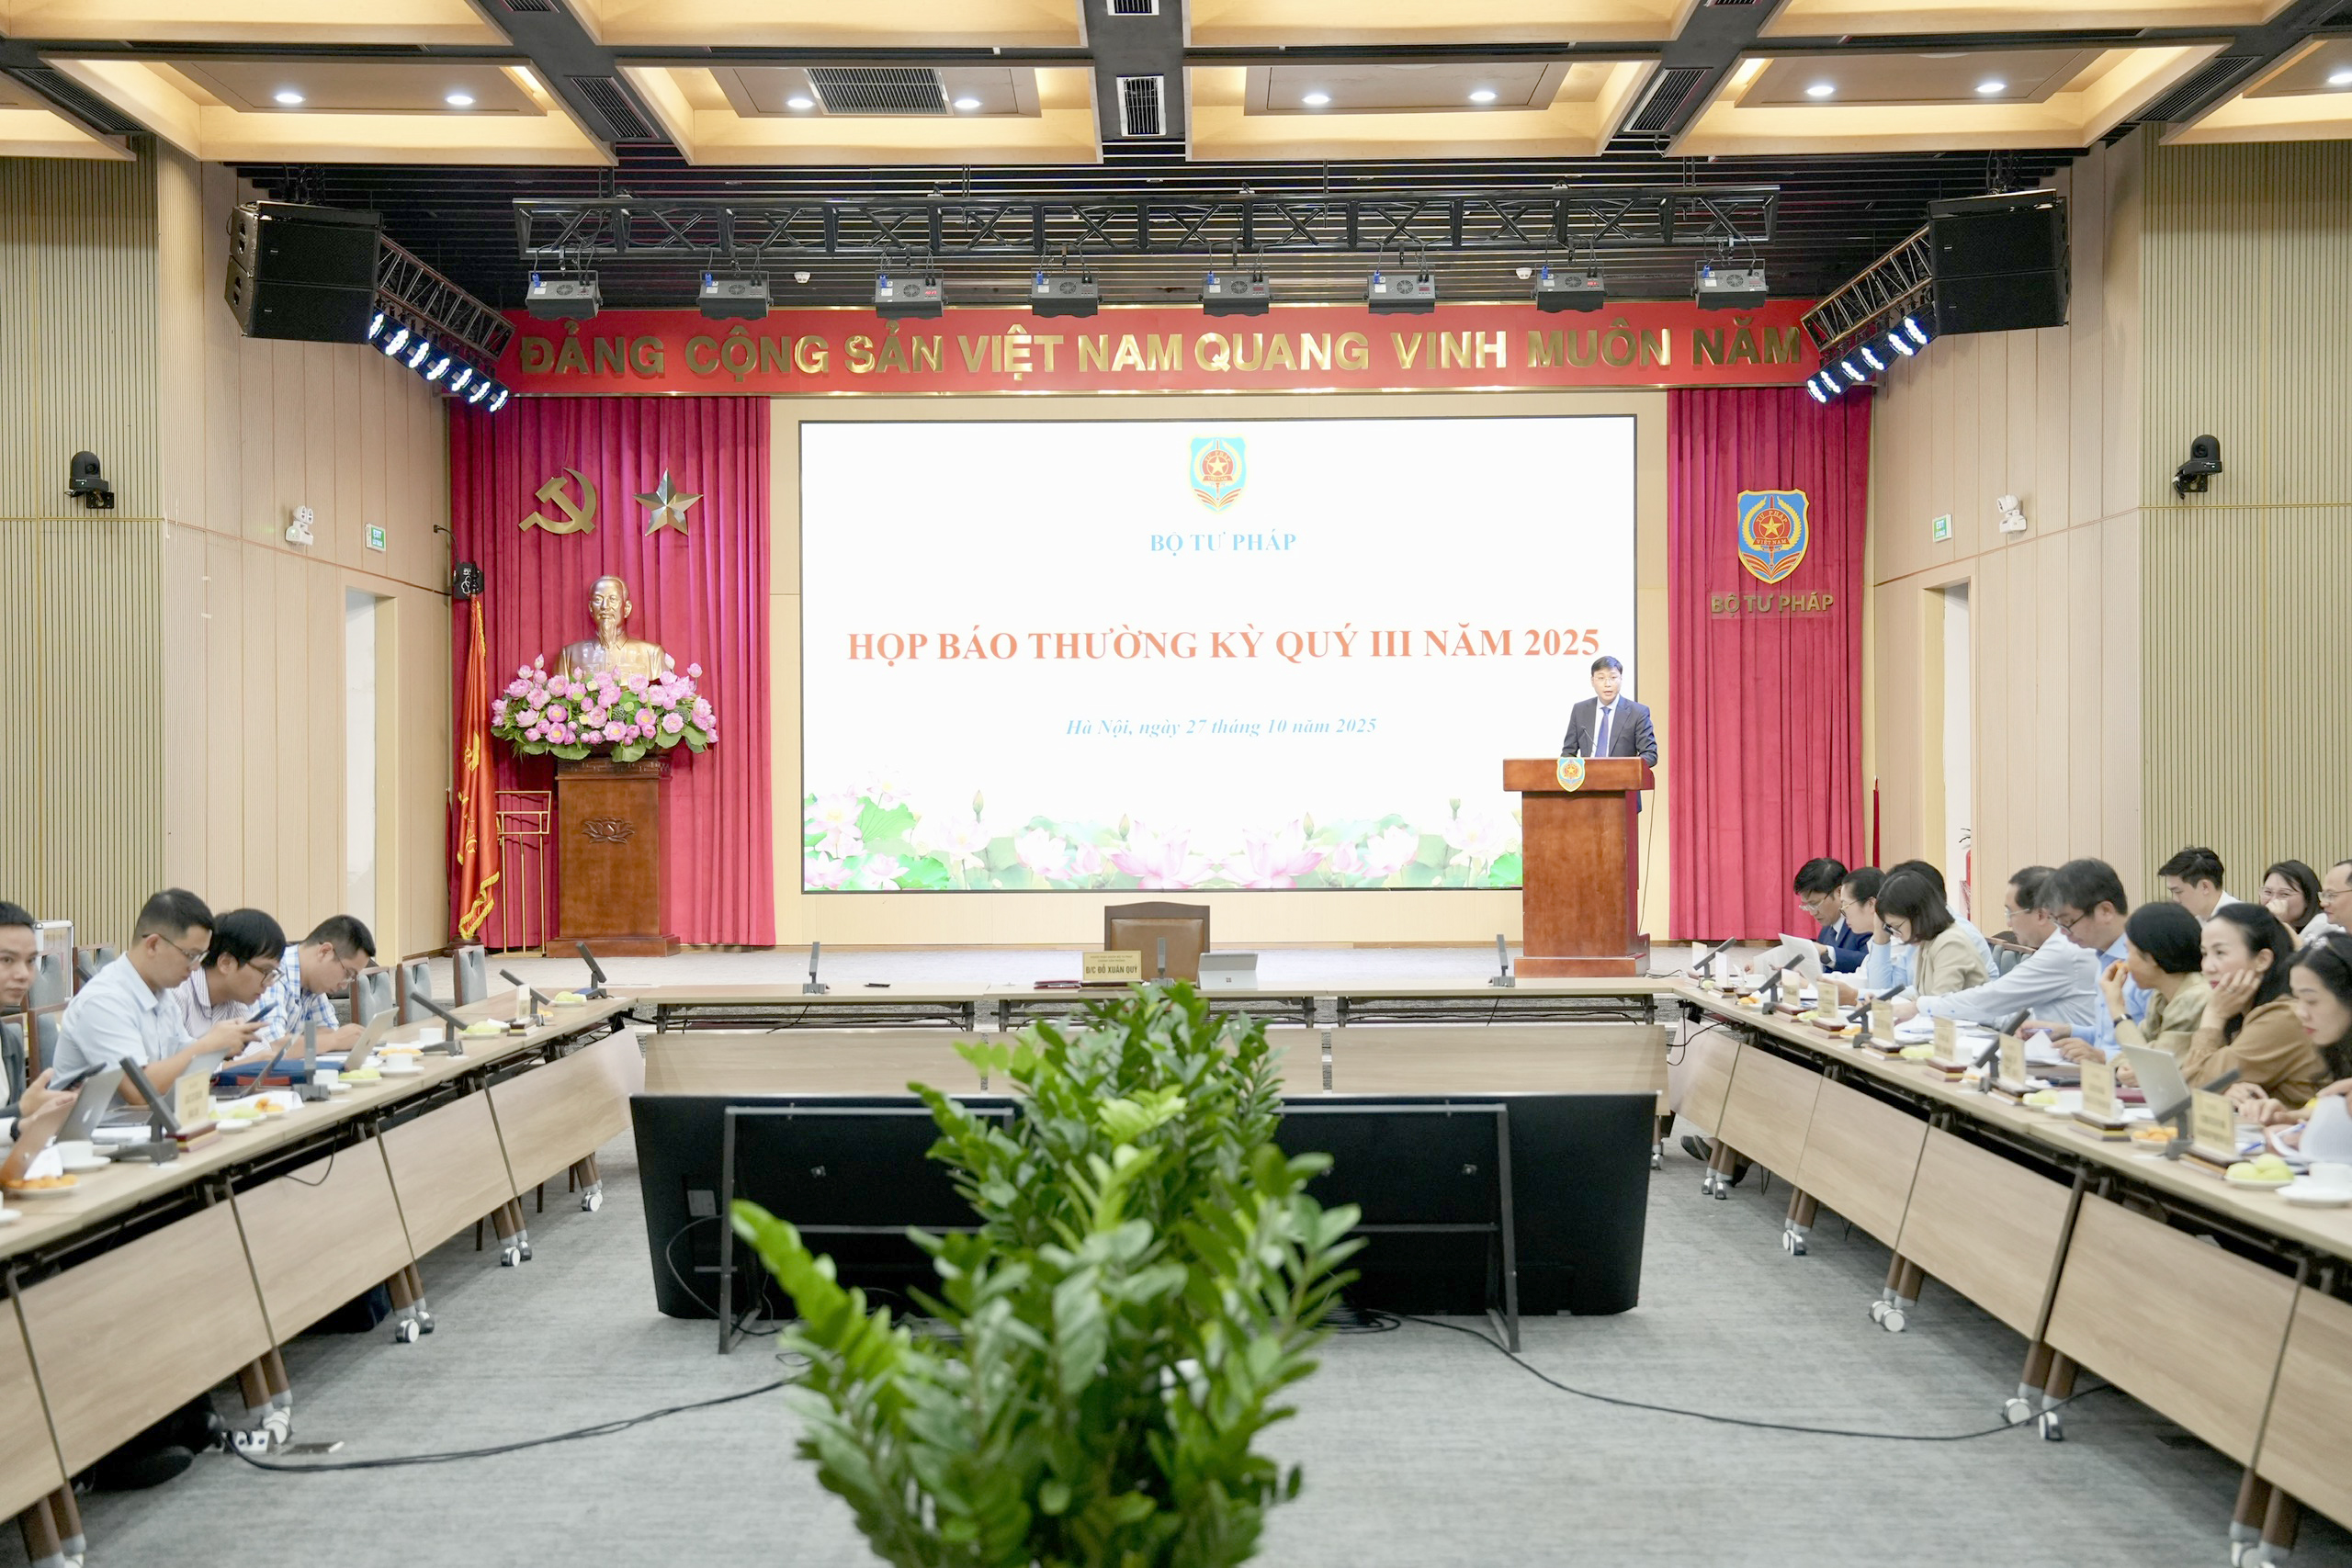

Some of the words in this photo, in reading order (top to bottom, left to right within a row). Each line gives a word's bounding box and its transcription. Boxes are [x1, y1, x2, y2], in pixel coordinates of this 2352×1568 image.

[519, 321, 665, 378] ĐẢNG
[684, 325, 830, 382] CỘNG
[844, 321, 944, 374] SẢN
[956, 323, 1064, 381] VIỆT
[1078, 333, 1183, 372] NAM
[1194, 332, 1369, 372] QUANG
[1390, 331, 1507, 370] VINH
[1527, 318, 1671, 367] MUÔN
[1691, 316, 1801, 366] NĂM
[1150, 531, 1183, 557] BỘ
[1190, 531, 1227, 551] TƯ
[1232, 528, 1297, 551] PHÁP
[1711, 593, 1741, 617] BỘ
[1744, 594, 1774, 614] TƯ
[1778, 591, 1835, 613] PHÁP
[847, 632, 929, 668] HỌP
[936, 625, 1018, 660] BÁO
[1027, 624, 1198, 660] THƯỜNG
[1209, 623, 1264, 659] KỲ
[1275, 623, 1359, 664] QUÝ
[1369, 630, 1412, 658] III
[1423, 622, 1513, 657] NĂM
[1524, 628, 1600, 657] 2025
[1066, 719, 1092, 736] Hà
[1097, 719, 1134, 739] Nội,
[1139, 719, 1181, 739] ngày
[1186, 719, 1207, 735] 27
[1211, 719, 1261, 738] tháng
[1268, 719, 1288, 734] 10
[1292, 719, 1330, 734] năm
[1336, 718, 1378, 734] 2025
